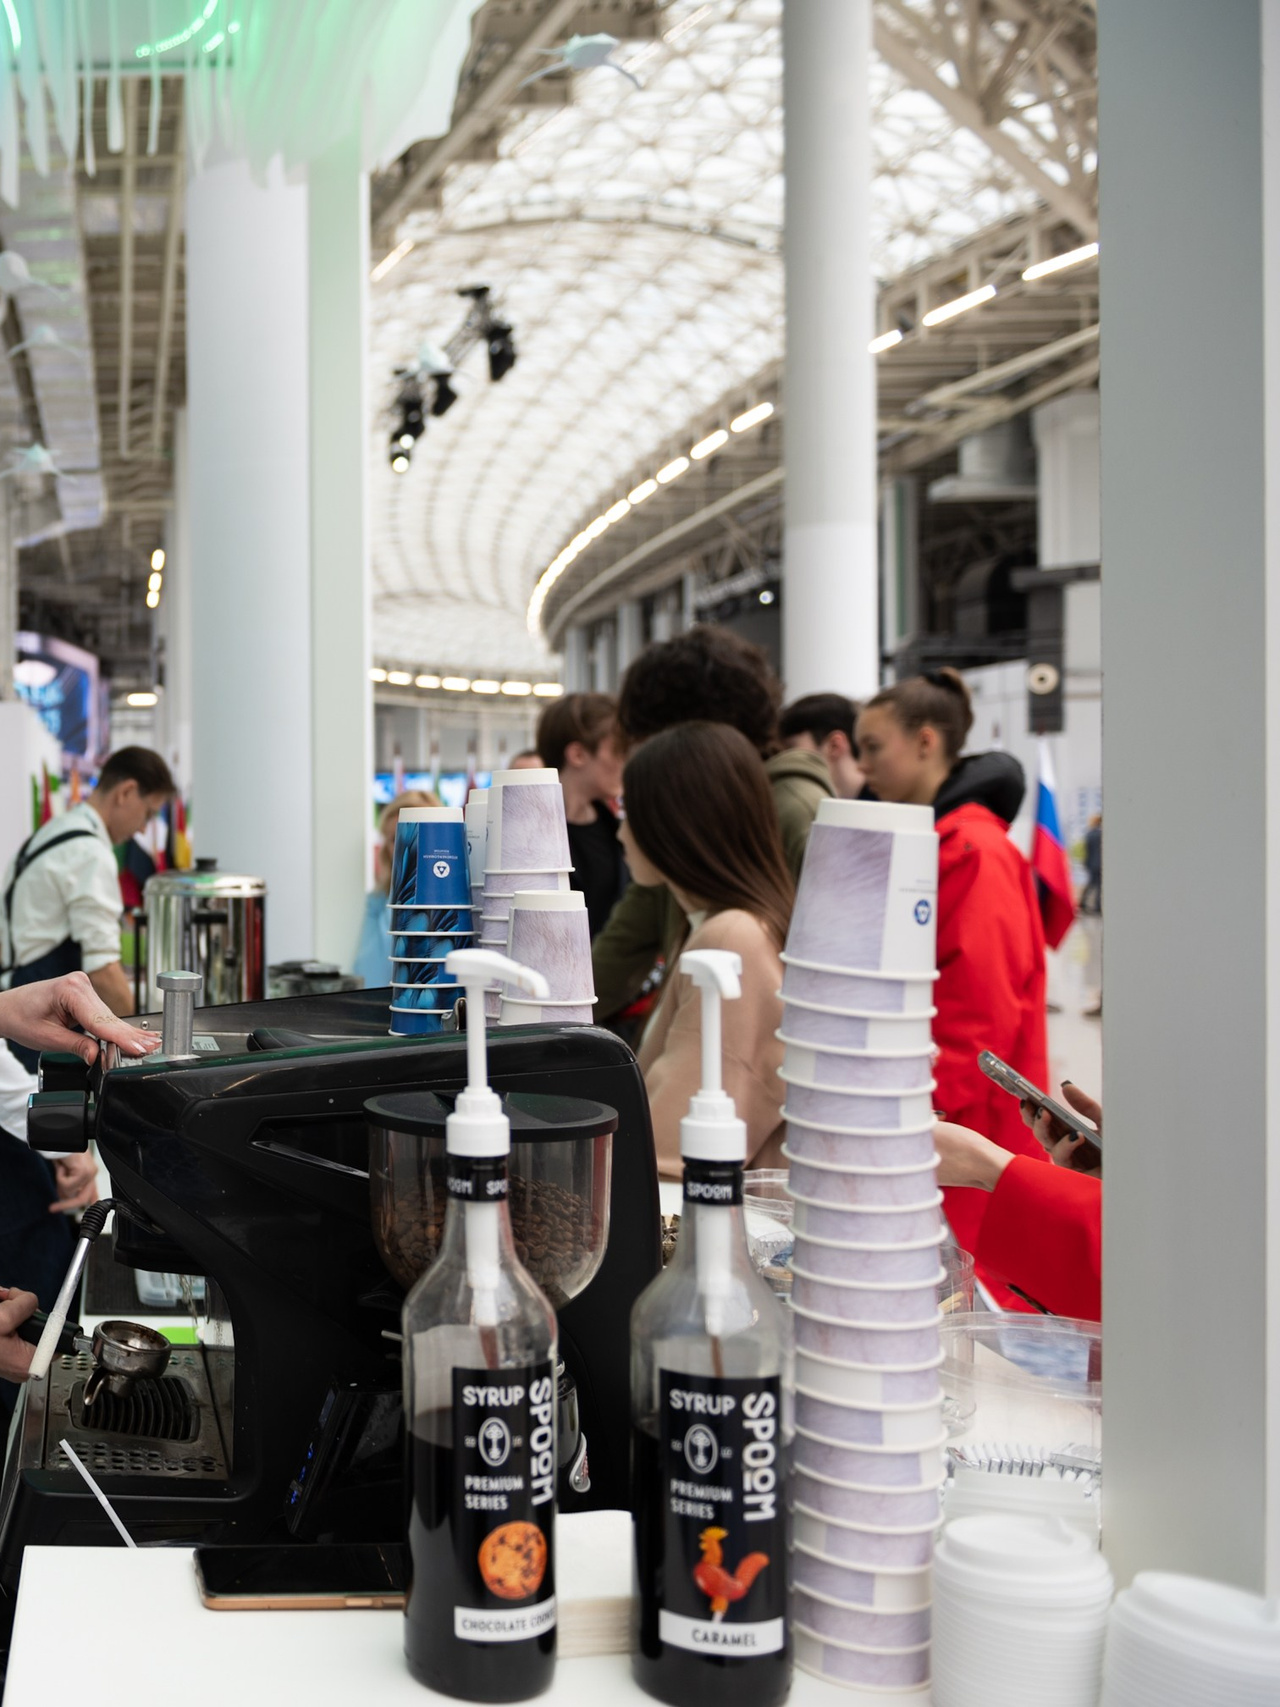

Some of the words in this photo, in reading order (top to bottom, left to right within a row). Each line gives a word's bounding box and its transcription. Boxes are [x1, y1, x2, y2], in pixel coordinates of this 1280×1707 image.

[462, 1385, 525, 1407] SYRUP
[669, 1387, 737, 1416] SYRUP
[528, 1376, 554, 1507] SPOOM
[741, 1391, 777, 1522] SPOOM
[464, 1474, 524, 1492] PREMIUM
[670, 1478, 733, 1503] PREMIUM
[464, 1493, 509, 1511] SERIES
[670, 1497, 715, 1520] SERIES
[462, 1617, 527, 1633] CHOCOLATE
[691, 1627, 757, 1648] CARAMEL
